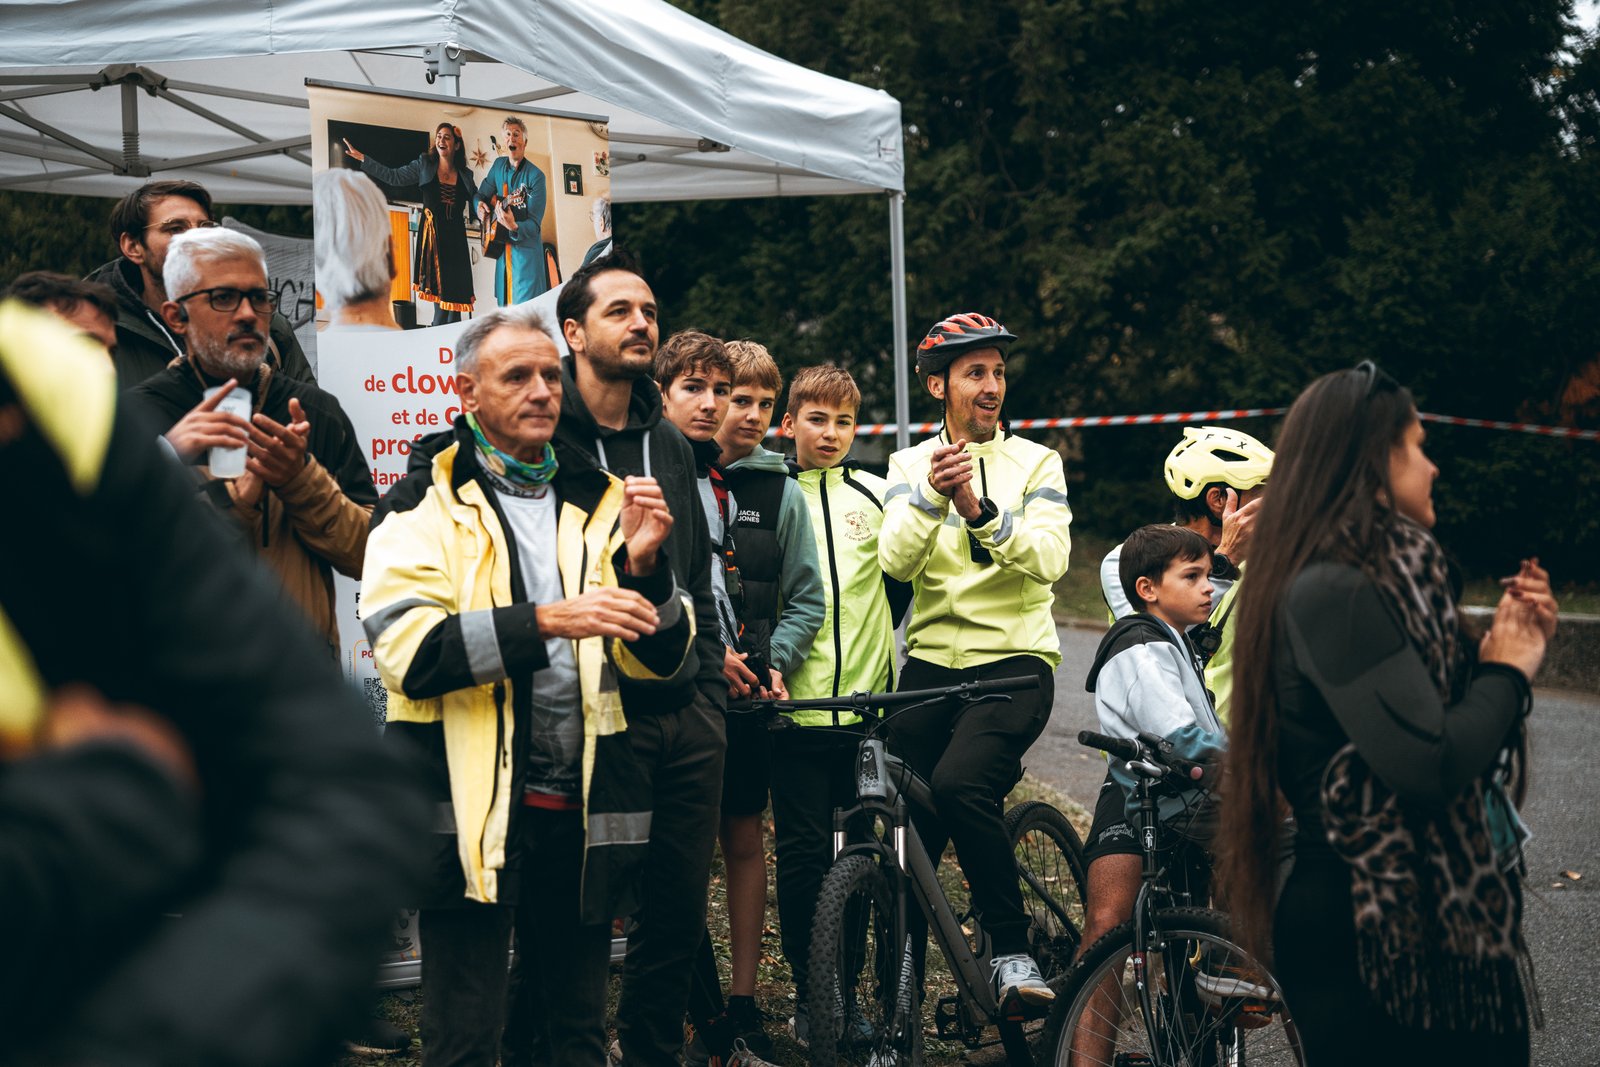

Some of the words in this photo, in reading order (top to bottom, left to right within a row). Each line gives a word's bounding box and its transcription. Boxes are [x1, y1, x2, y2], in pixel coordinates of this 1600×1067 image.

[439, 347, 454, 364] D
[364, 375, 386, 392] de
[391, 366, 459, 394] clow
[392, 409, 410, 425] et
[415, 408, 439, 425] de
[361, 650, 374, 659] PO
